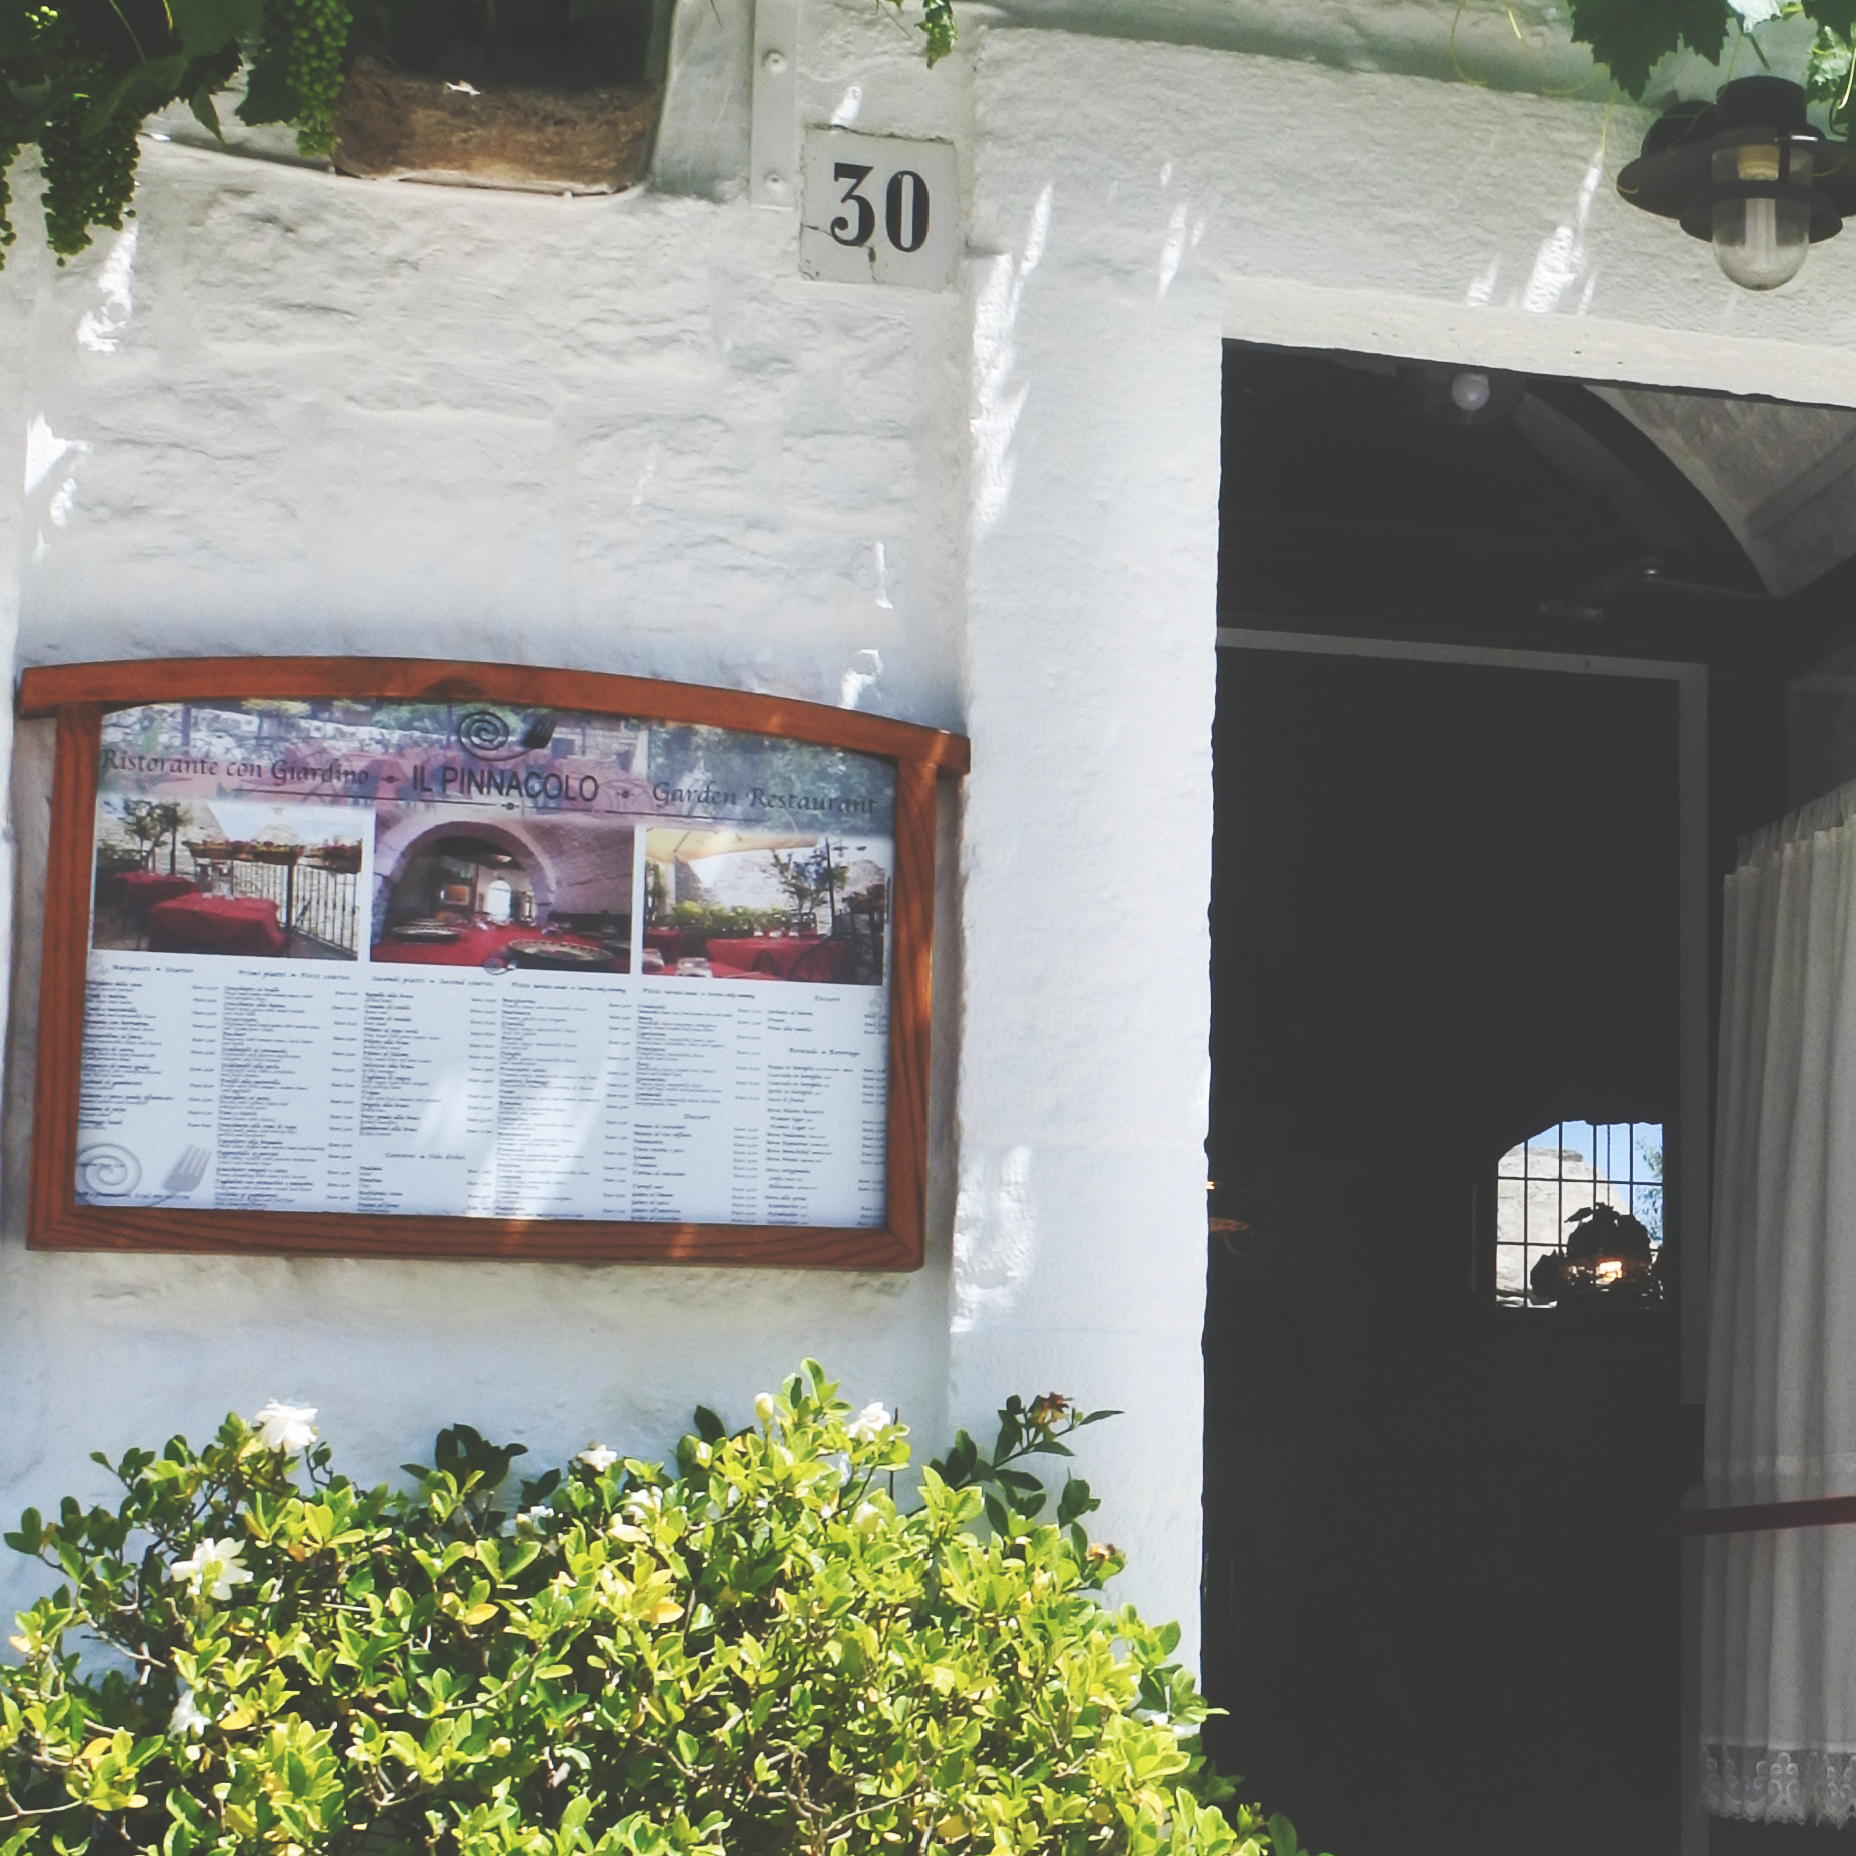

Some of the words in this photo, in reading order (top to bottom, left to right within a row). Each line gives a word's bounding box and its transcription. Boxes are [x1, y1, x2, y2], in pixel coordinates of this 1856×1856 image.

[830, 162, 930, 253] 30
[101, 748, 218, 776] Ristorante
[226, 760, 262, 779] con
[270, 757, 369, 787] Giardino
[413, 764, 433, 793] IL
[442, 765, 600, 802] PINNACOLO
[652, 780, 737, 809] Garden
[748, 786, 878, 815] Restaurant
